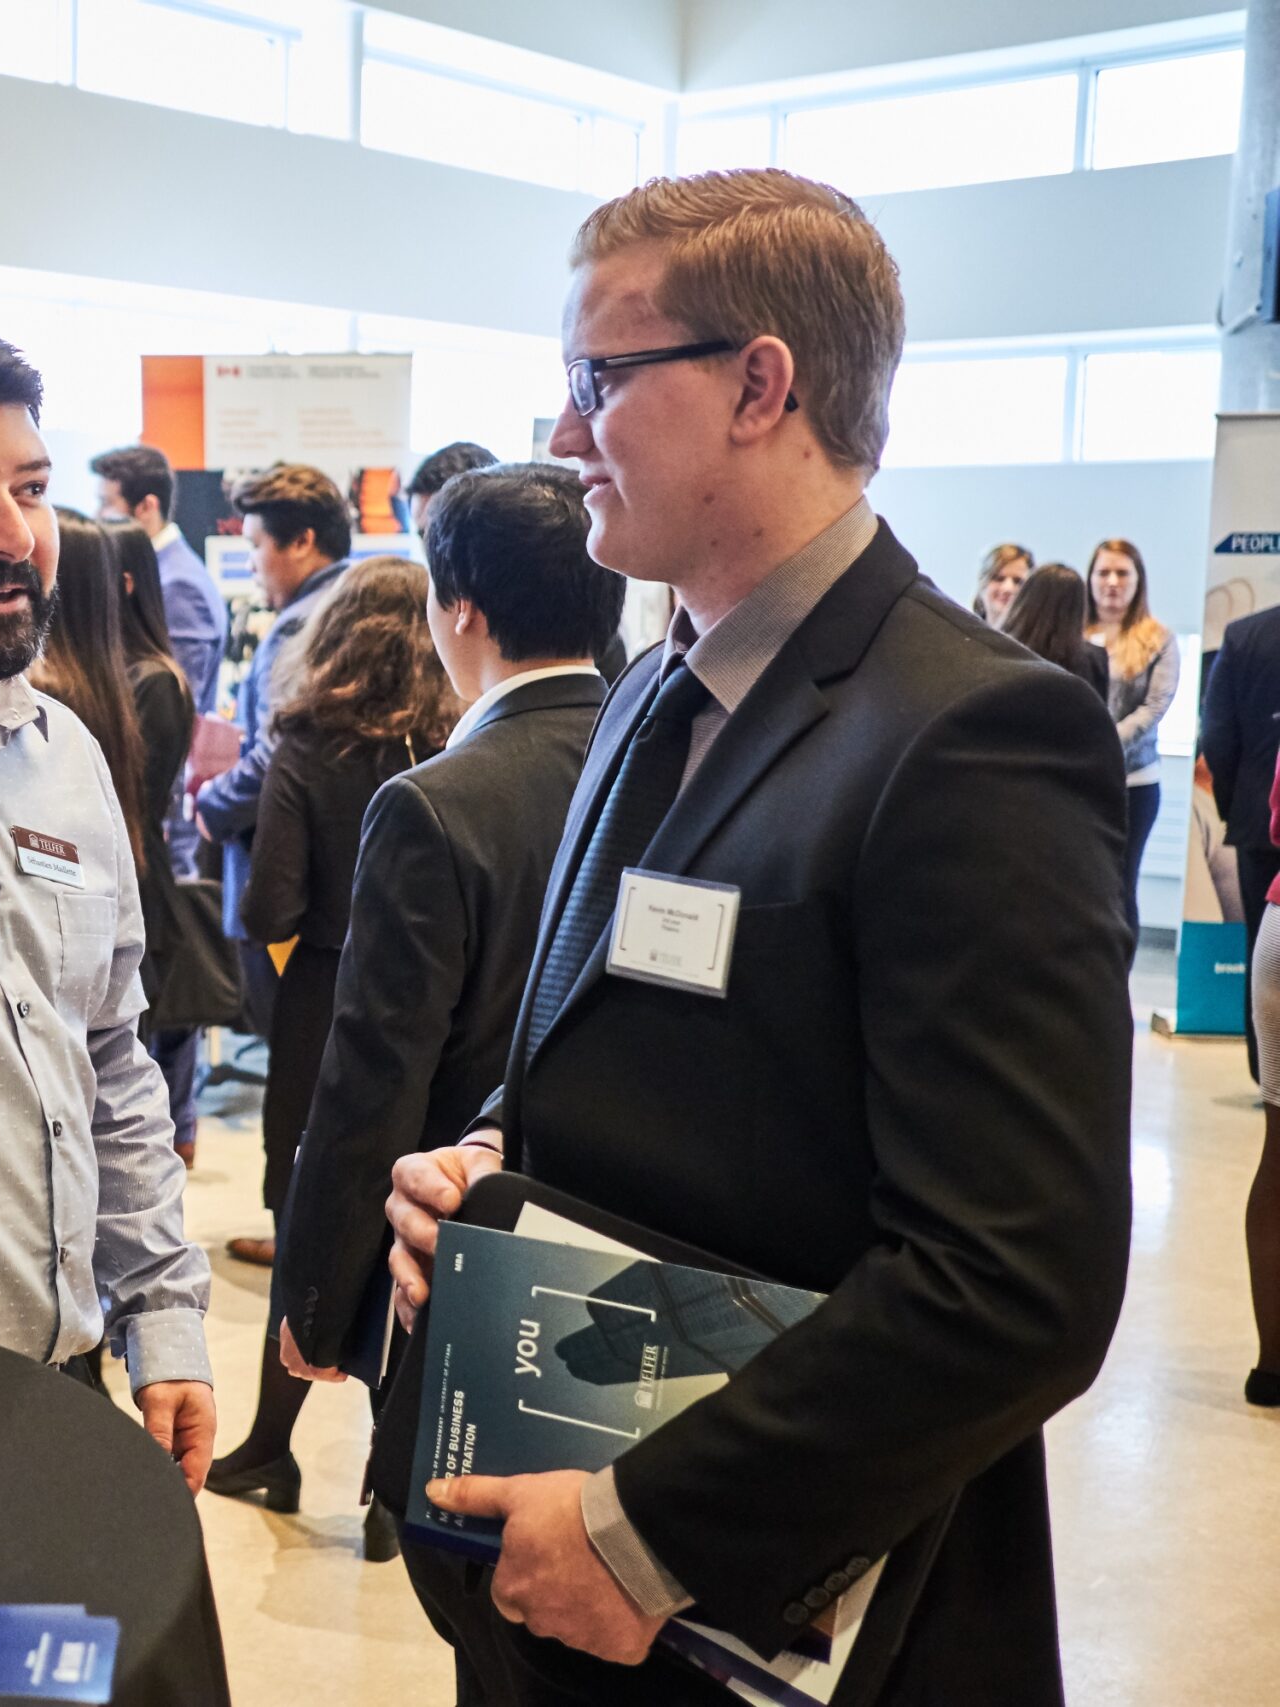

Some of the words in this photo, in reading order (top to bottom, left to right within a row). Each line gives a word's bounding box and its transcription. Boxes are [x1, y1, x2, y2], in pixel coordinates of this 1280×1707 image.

[1232, 534, 1280, 553] PEOPL
[39, 839, 66, 856] TELFER
[454, 1253, 464, 1272] MBA
[515, 1319, 542, 1378] you
[639, 1343, 659, 1388] TELFER
[449, 1390, 465, 1452] BUSINESS
[446, 1453, 457, 1469] OF
